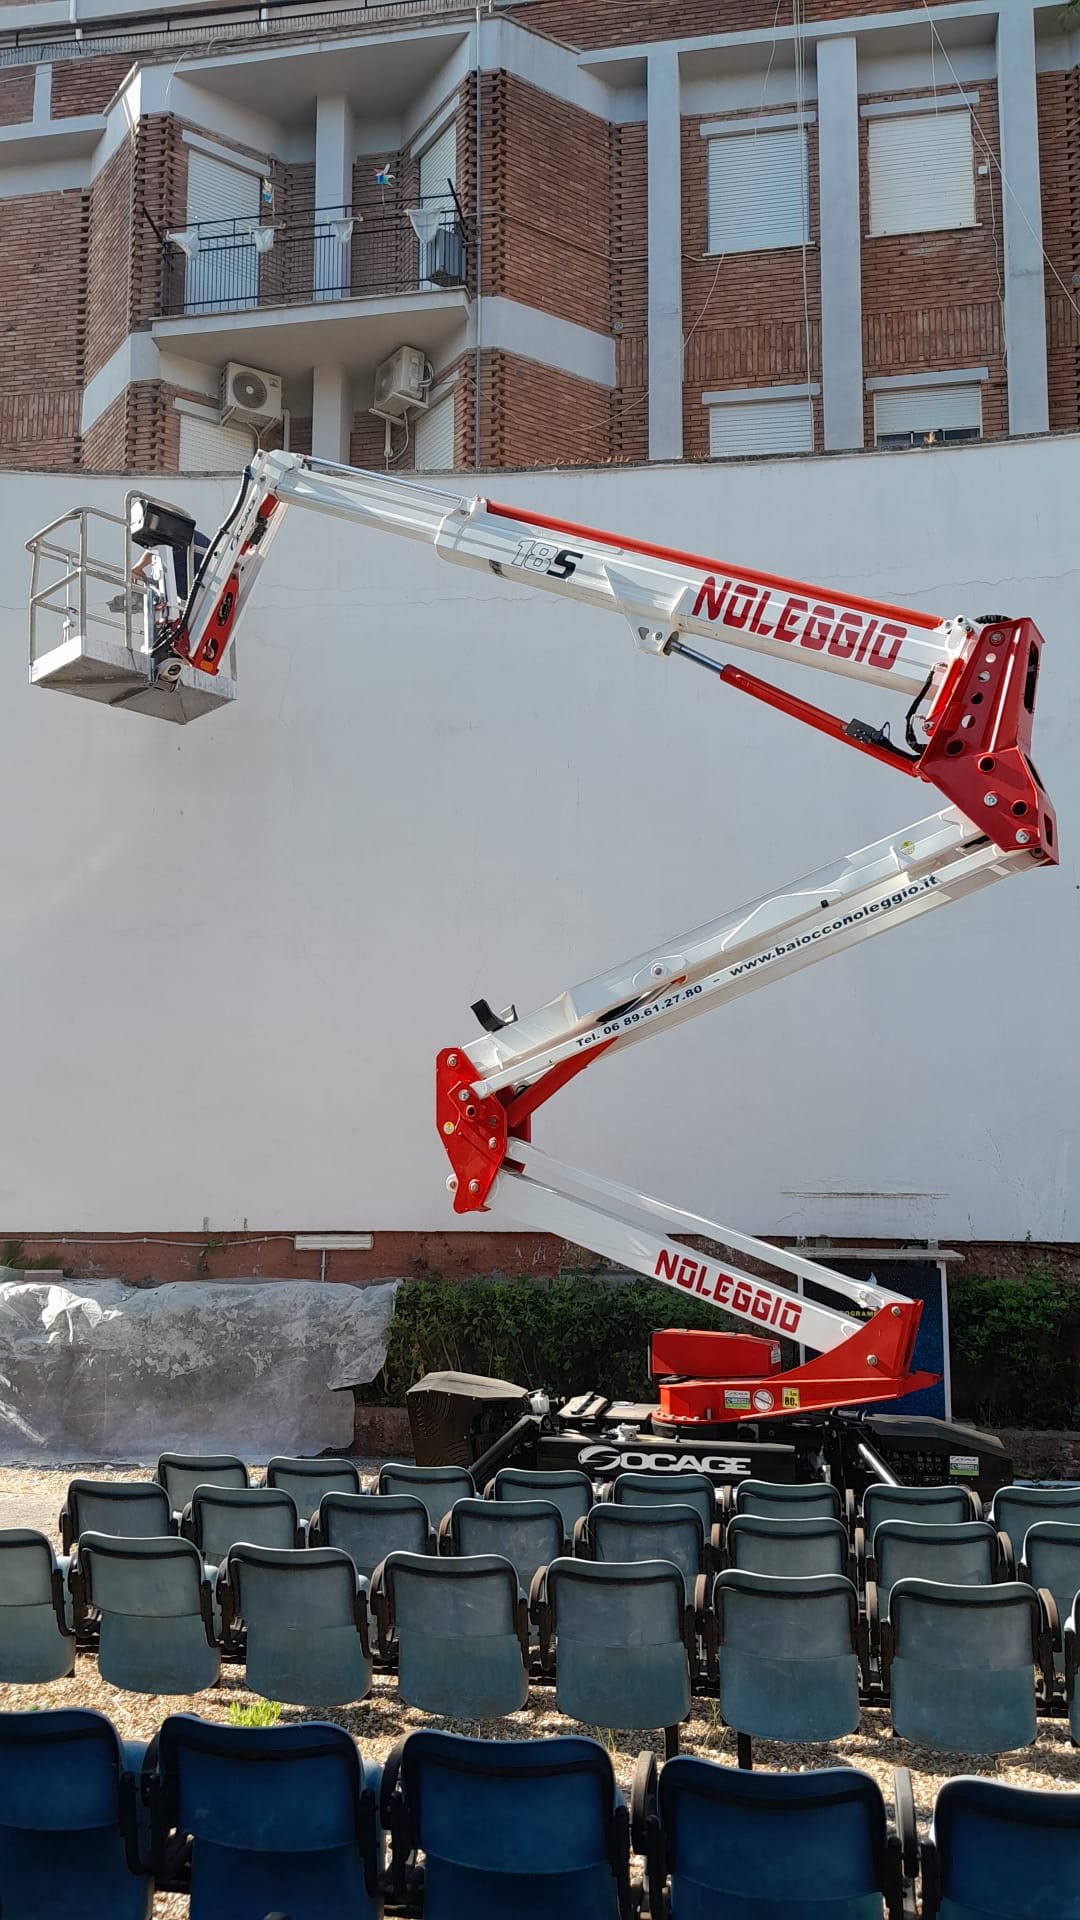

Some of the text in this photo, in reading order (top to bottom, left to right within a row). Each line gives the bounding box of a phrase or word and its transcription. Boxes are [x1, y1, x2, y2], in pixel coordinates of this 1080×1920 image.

[511, 540, 584, 579] 18S
[691, 576, 907, 670] NOLEGGIO
[576, 1034, 600, 1047] Tel.
[603, 1023, 620, 1035] 06
[623, 985, 703, 1026] 89.61.27.80
[729, 875, 938, 977] www.baiocconoleggio.it
[655, 1249, 803, 1334] NOLEGGIO
[578, 1445, 752, 1475] SOCAGE
